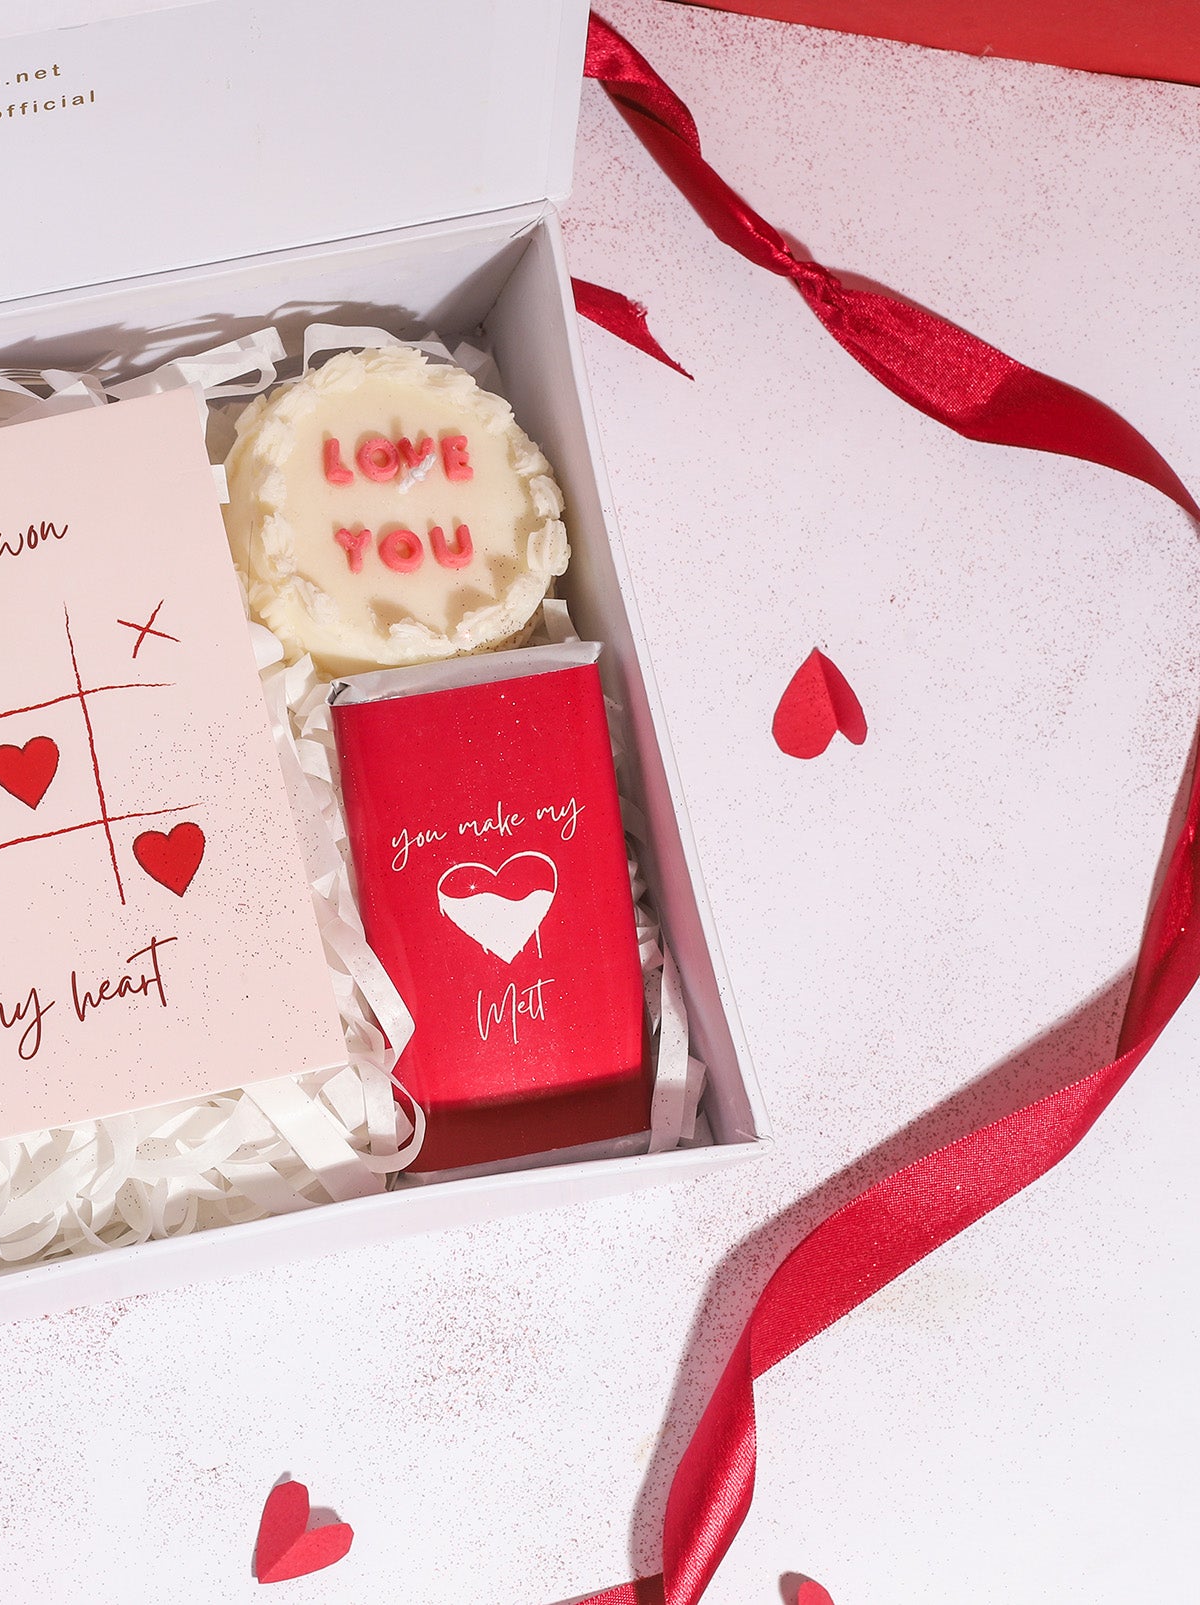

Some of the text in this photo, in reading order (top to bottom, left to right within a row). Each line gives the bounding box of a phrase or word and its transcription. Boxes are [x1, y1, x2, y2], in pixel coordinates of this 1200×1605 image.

[323, 434, 474, 487] LOVE
[334, 524, 473, 575] YOU
[391, 797, 586, 872] you make my
[71, 936, 178, 1022] heart
[477, 978, 555, 1045] Melt
